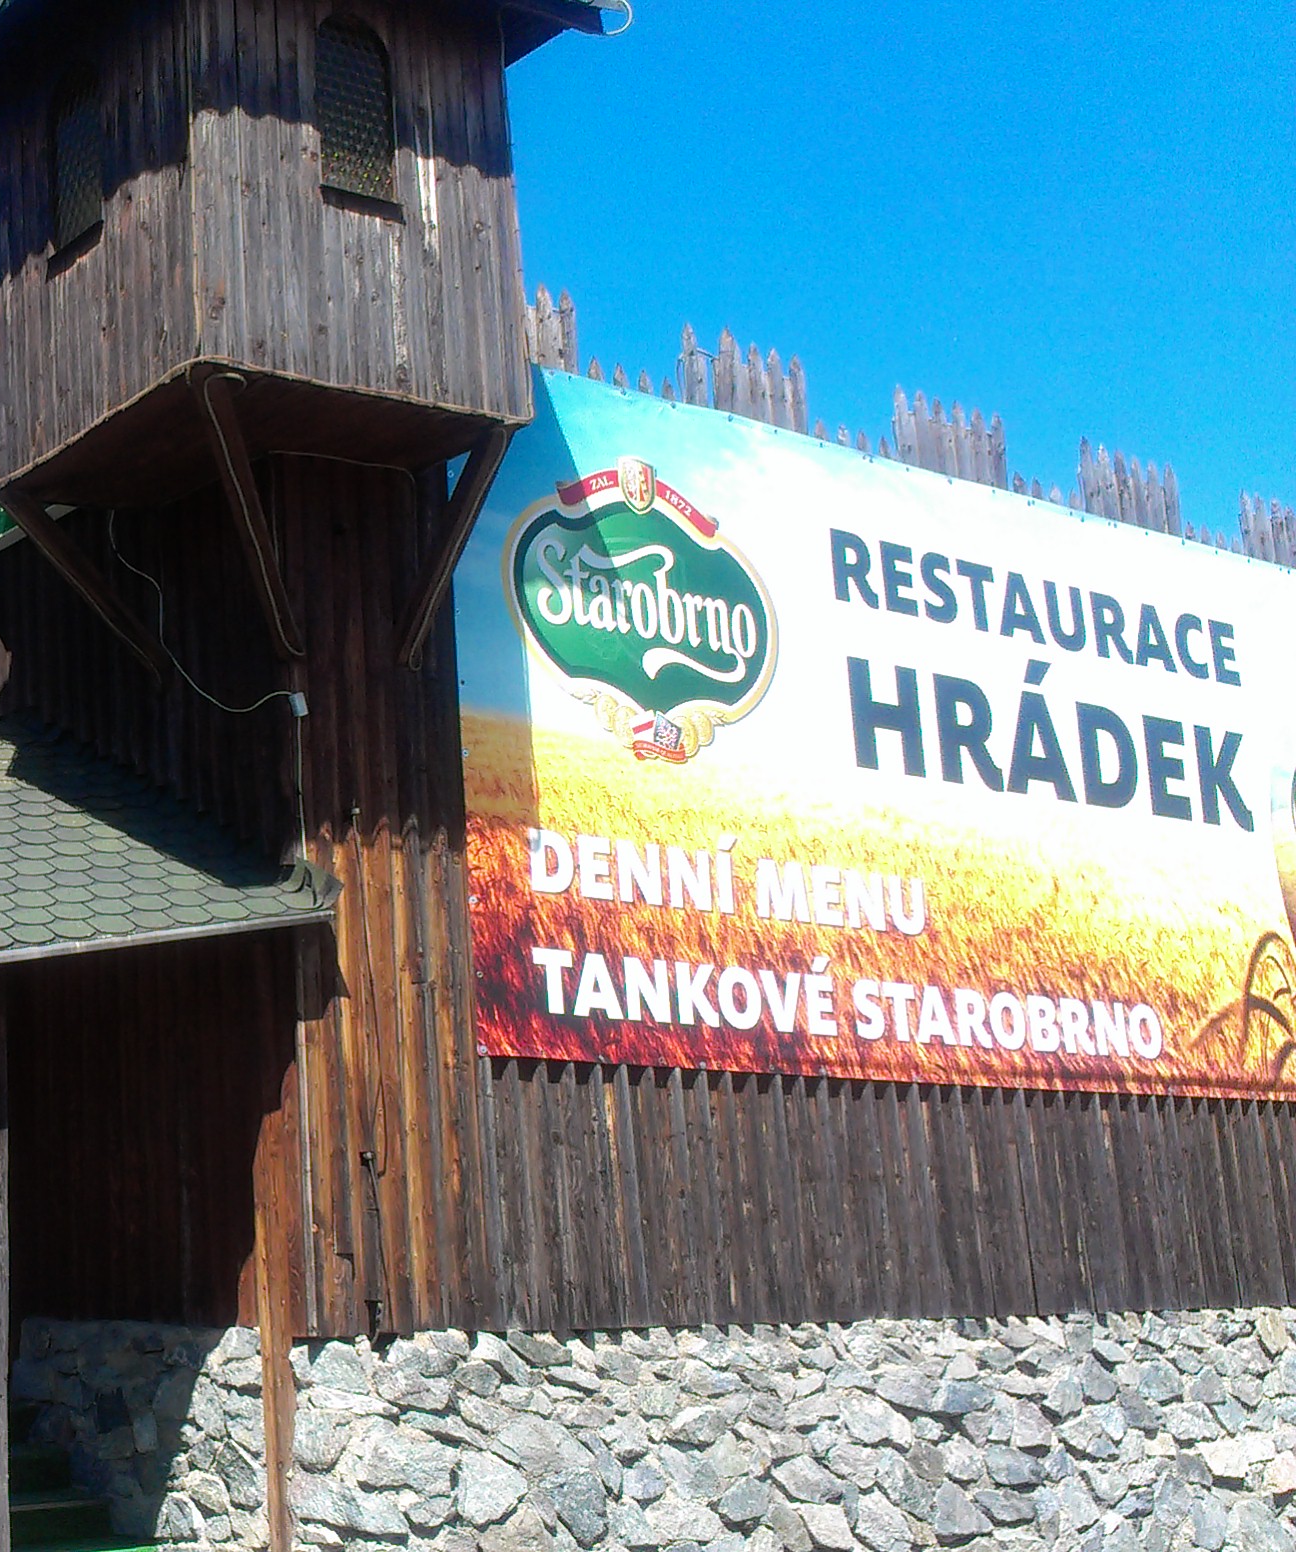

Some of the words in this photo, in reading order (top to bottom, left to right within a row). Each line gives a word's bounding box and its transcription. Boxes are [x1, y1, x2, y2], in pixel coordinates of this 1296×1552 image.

[665, 490, 692, 516] 1872
[536, 539, 757, 683] Starobrno
[830, 528, 1242, 686] RESTAURACE
[847, 656, 1255, 832] HRÁDEK
[530, 828, 738, 914] DENNÍ
[756, 858, 926, 936] MENU
[532, 947, 838, 1036] TANKOVÉ
[853, 979, 1162, 1059] STAROBRNO
